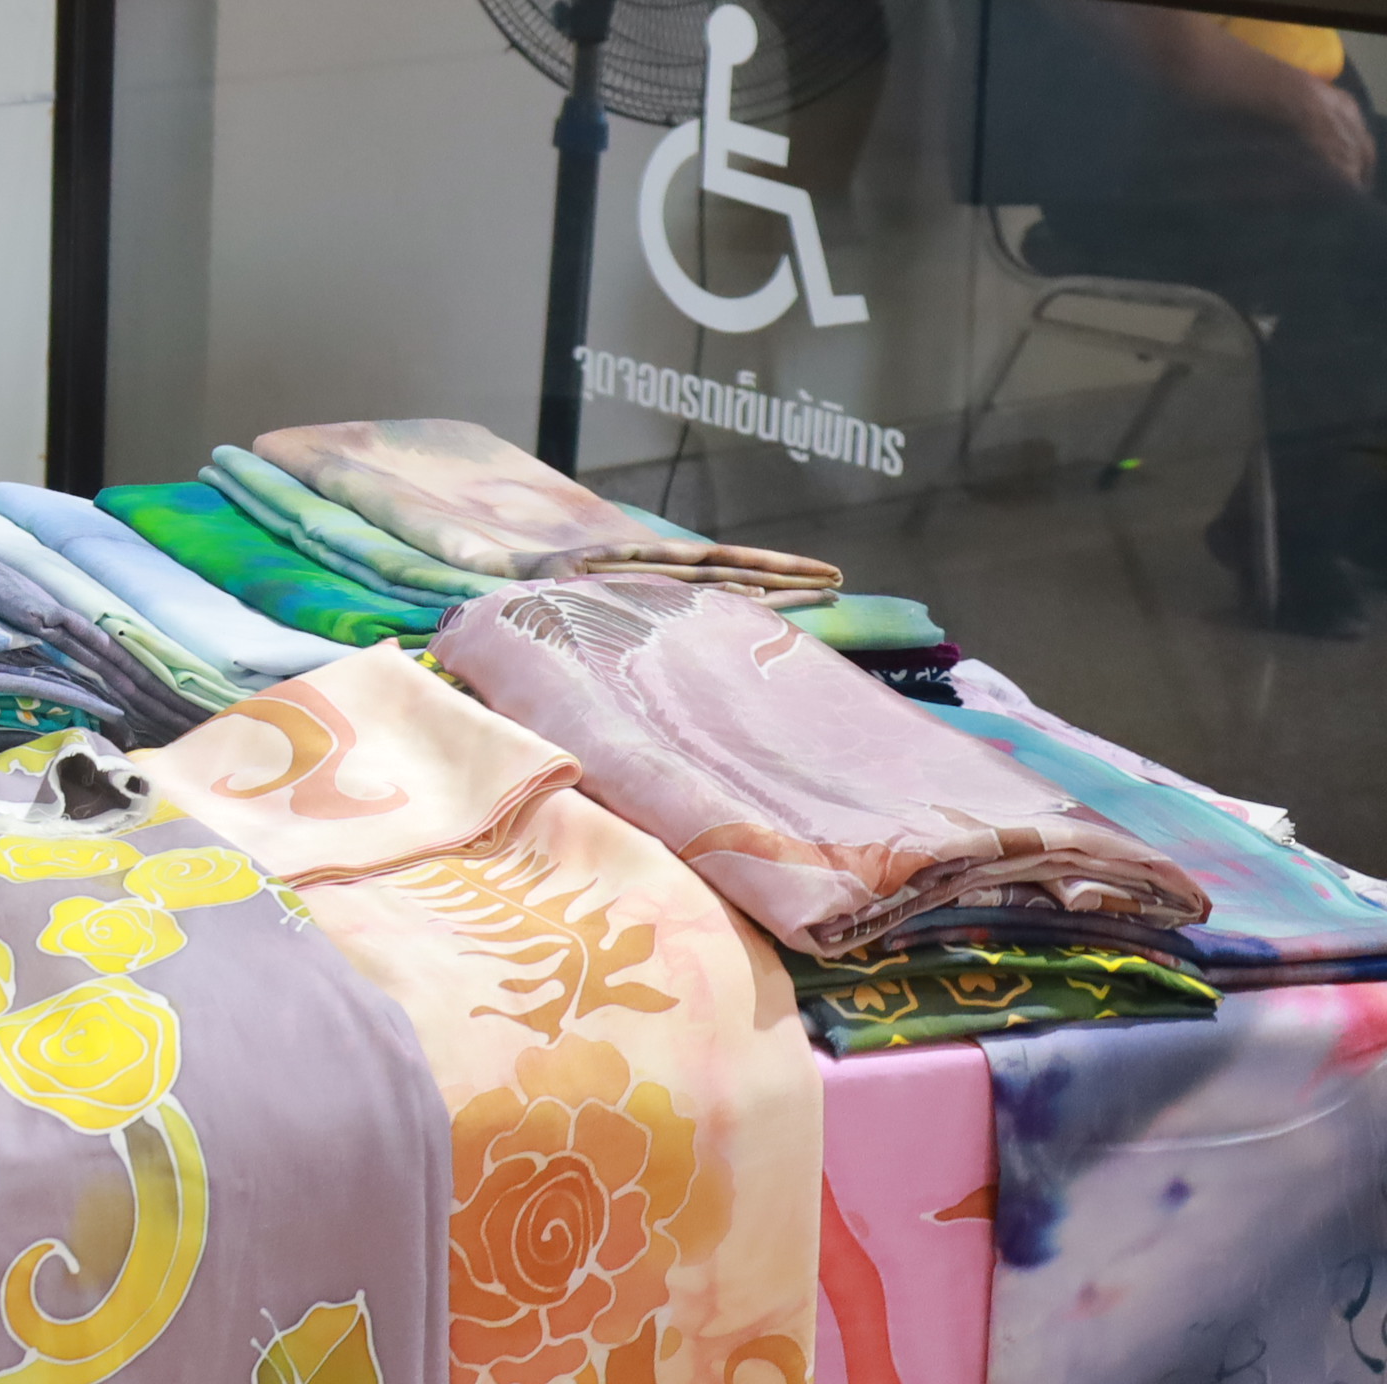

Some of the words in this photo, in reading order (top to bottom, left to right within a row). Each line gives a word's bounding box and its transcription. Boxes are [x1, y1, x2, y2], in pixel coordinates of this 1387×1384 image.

[573, 346, 906, 478] จุดจอดรถเข็นผู้พิการ
